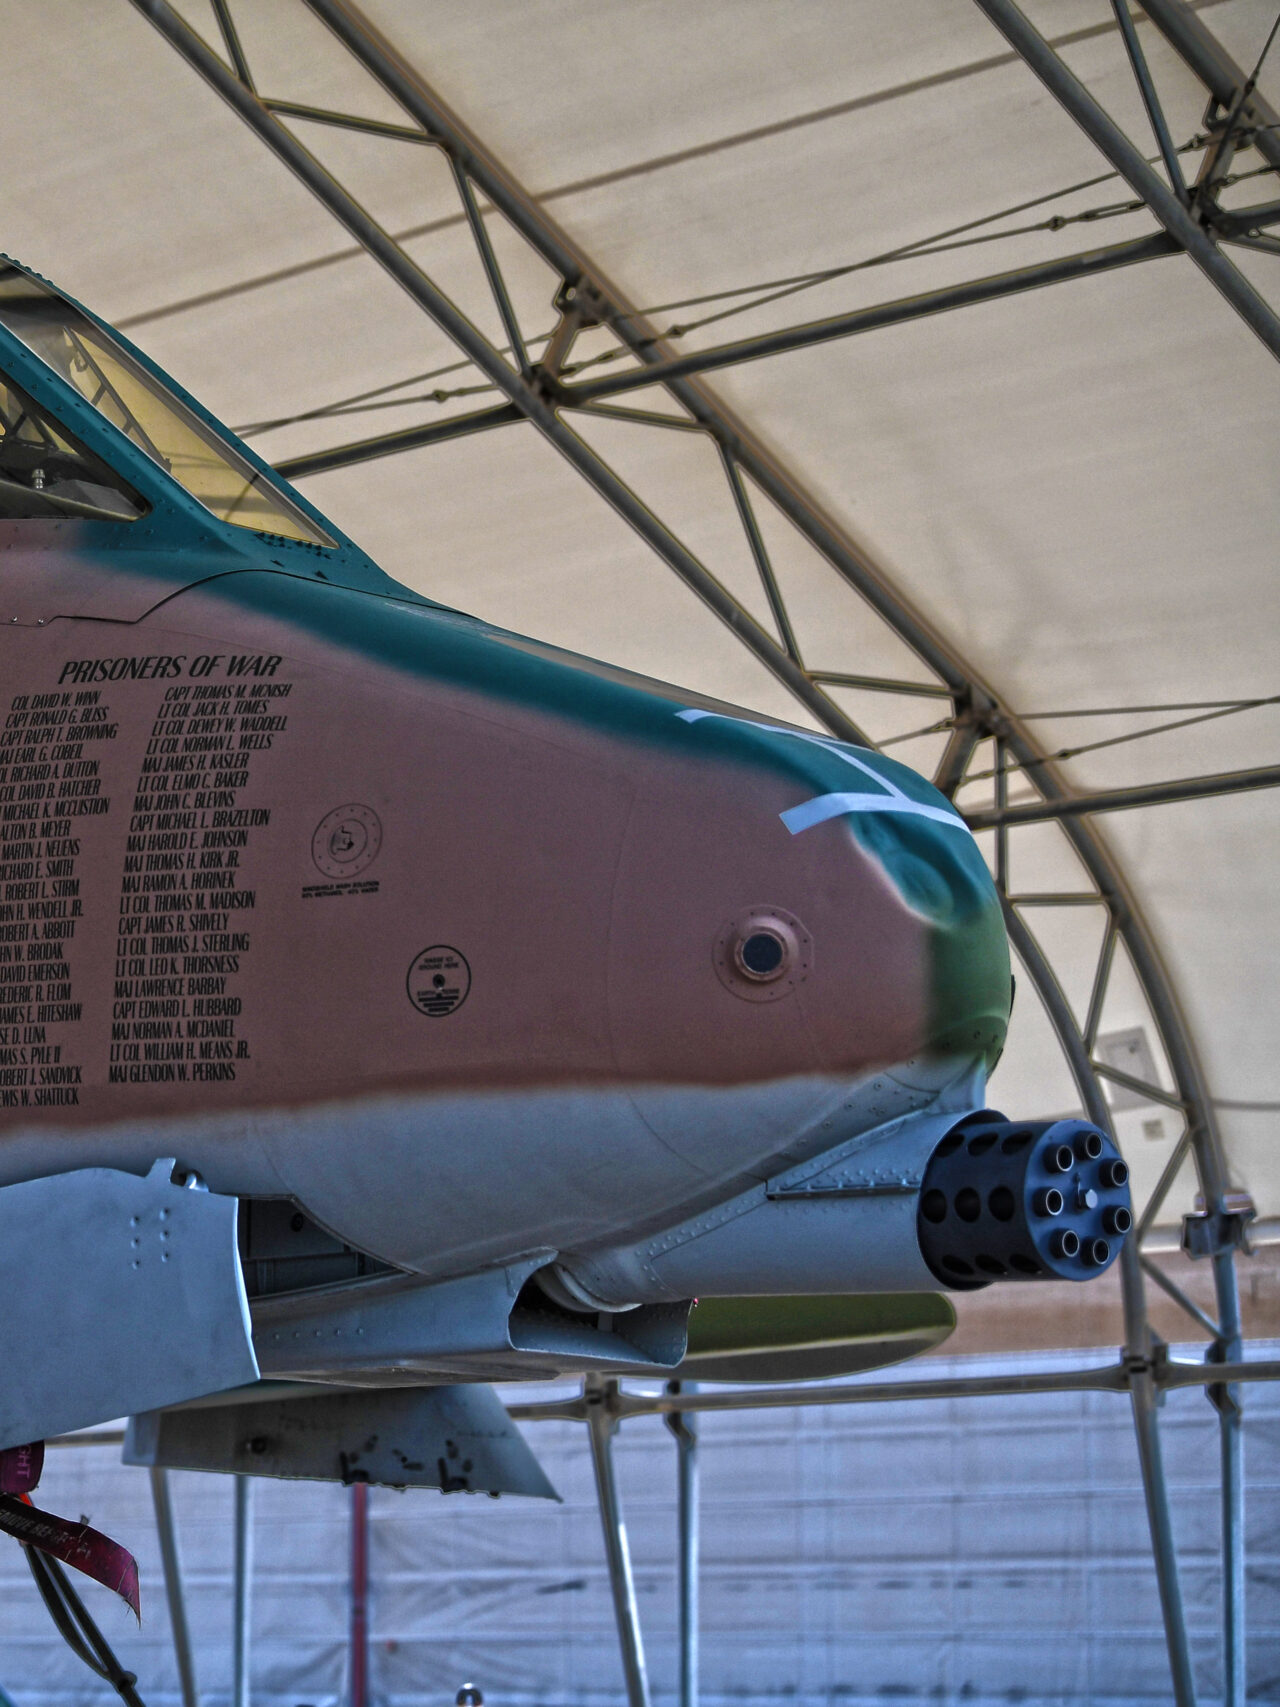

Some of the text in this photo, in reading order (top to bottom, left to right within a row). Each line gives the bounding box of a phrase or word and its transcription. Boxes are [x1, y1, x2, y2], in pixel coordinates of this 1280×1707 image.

[58, 655, 282, 684] PRISONERS OF WAR
[11, 690, 101, 711] COL DAVID W. WINN
[165, 684, 292, 700] CAPT THOMAS M. MCNISH
[152, 716, 288, 736] LT COL DEWEY W. WADDELL
[10, 764, 51, 782] RICHARD
[53, 763, 60, 779] A.
[62, 760, 100, 778] DUTTON
[142, 753, 250, 773] MAJ JAMES H. KASLER
[130, 809, 270, 832] CAPT MICHAEL L. BRAZELTON
[127, 830, 248, 852] MAJ HAROLD E. JOHNSON
[124, 850, 240, 872] MAJ THOMAS H. KIRK JR.
[118, 933, 250, 956] LT COL THOMAS J. STERLING
[0, 965, 25, 983] DAVID
[28, 963, 70, 982] EMERSON
[113, 997, 242, 1019] CAPT EDWARD L. HUBBARD
[12, 1027, 20, 1044] D.
[24, 1026, 46, 1043] LUNA
[21, 1048, 28, 1065] S.
[31, 1046, 52, 1064] PYLE
[54, 1046, 61, 1063] II
[109, 1063, 236, 1083] MAJ GLENDON W. PERKINS
[21, 1089, 32, 1107] W.
[34, 1087, 79, 1106] SHATTUCK
